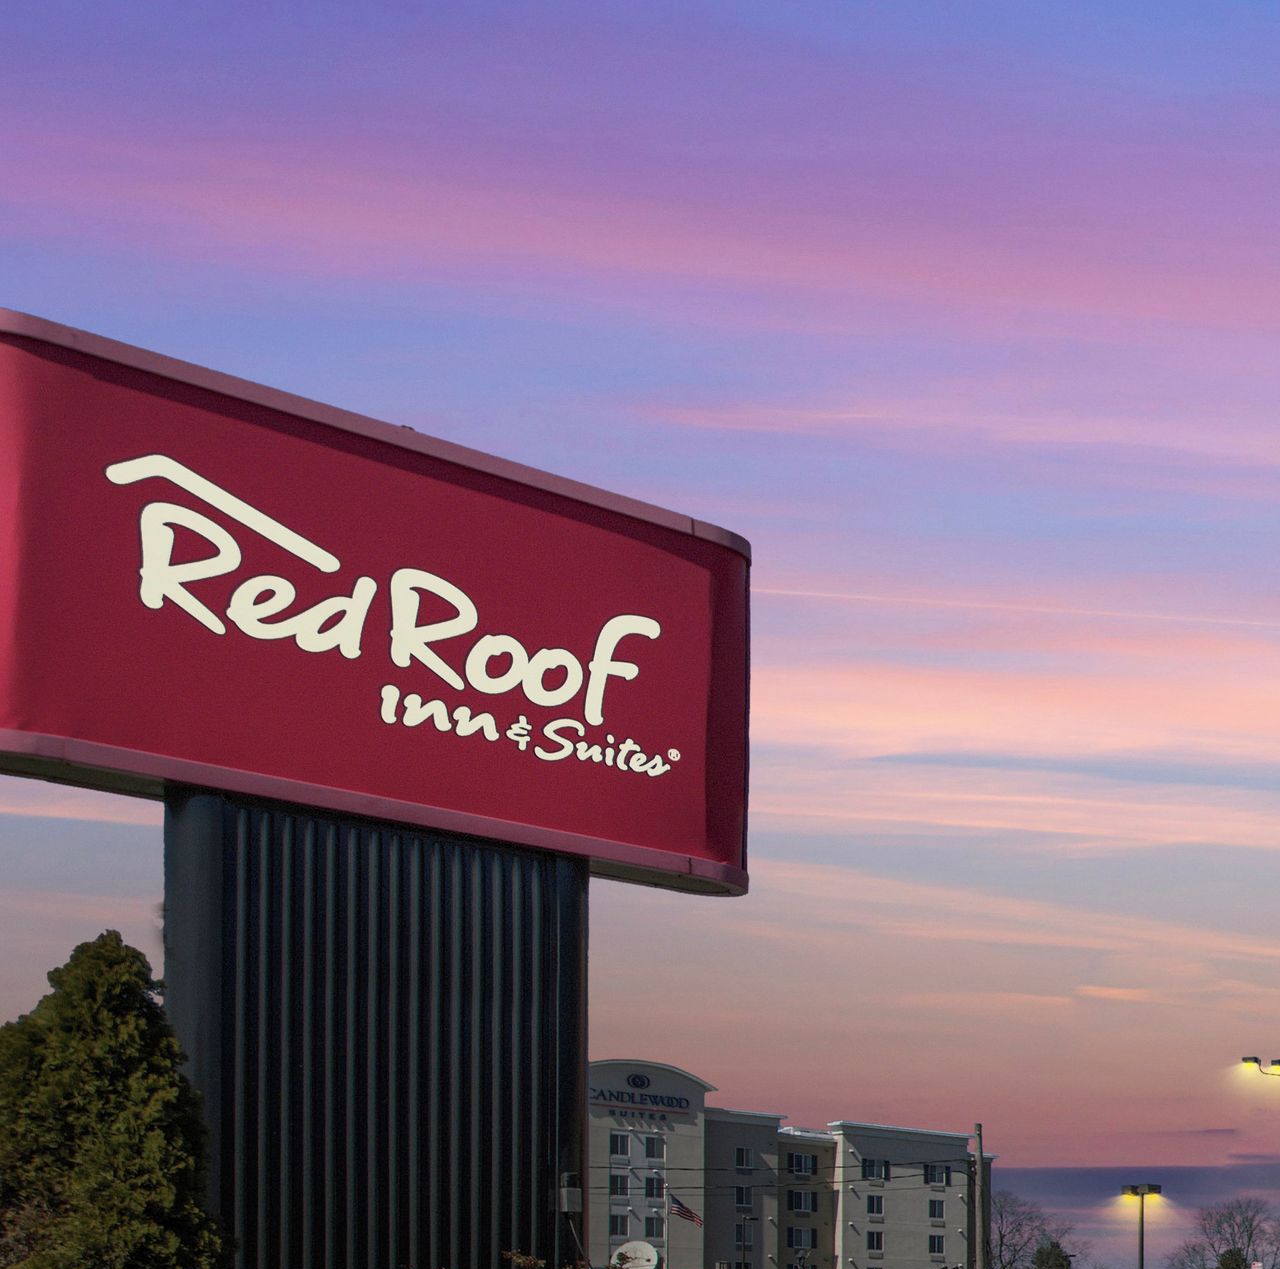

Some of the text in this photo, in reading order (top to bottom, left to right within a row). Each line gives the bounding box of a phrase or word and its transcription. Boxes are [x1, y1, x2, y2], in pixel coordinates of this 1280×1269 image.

[139, 502, 661, 724] Red Roof
[380, 684, 500, 742] Inn
[505, 715, 533, 751] &
[609, 1109, 667, 1120] SUITES
